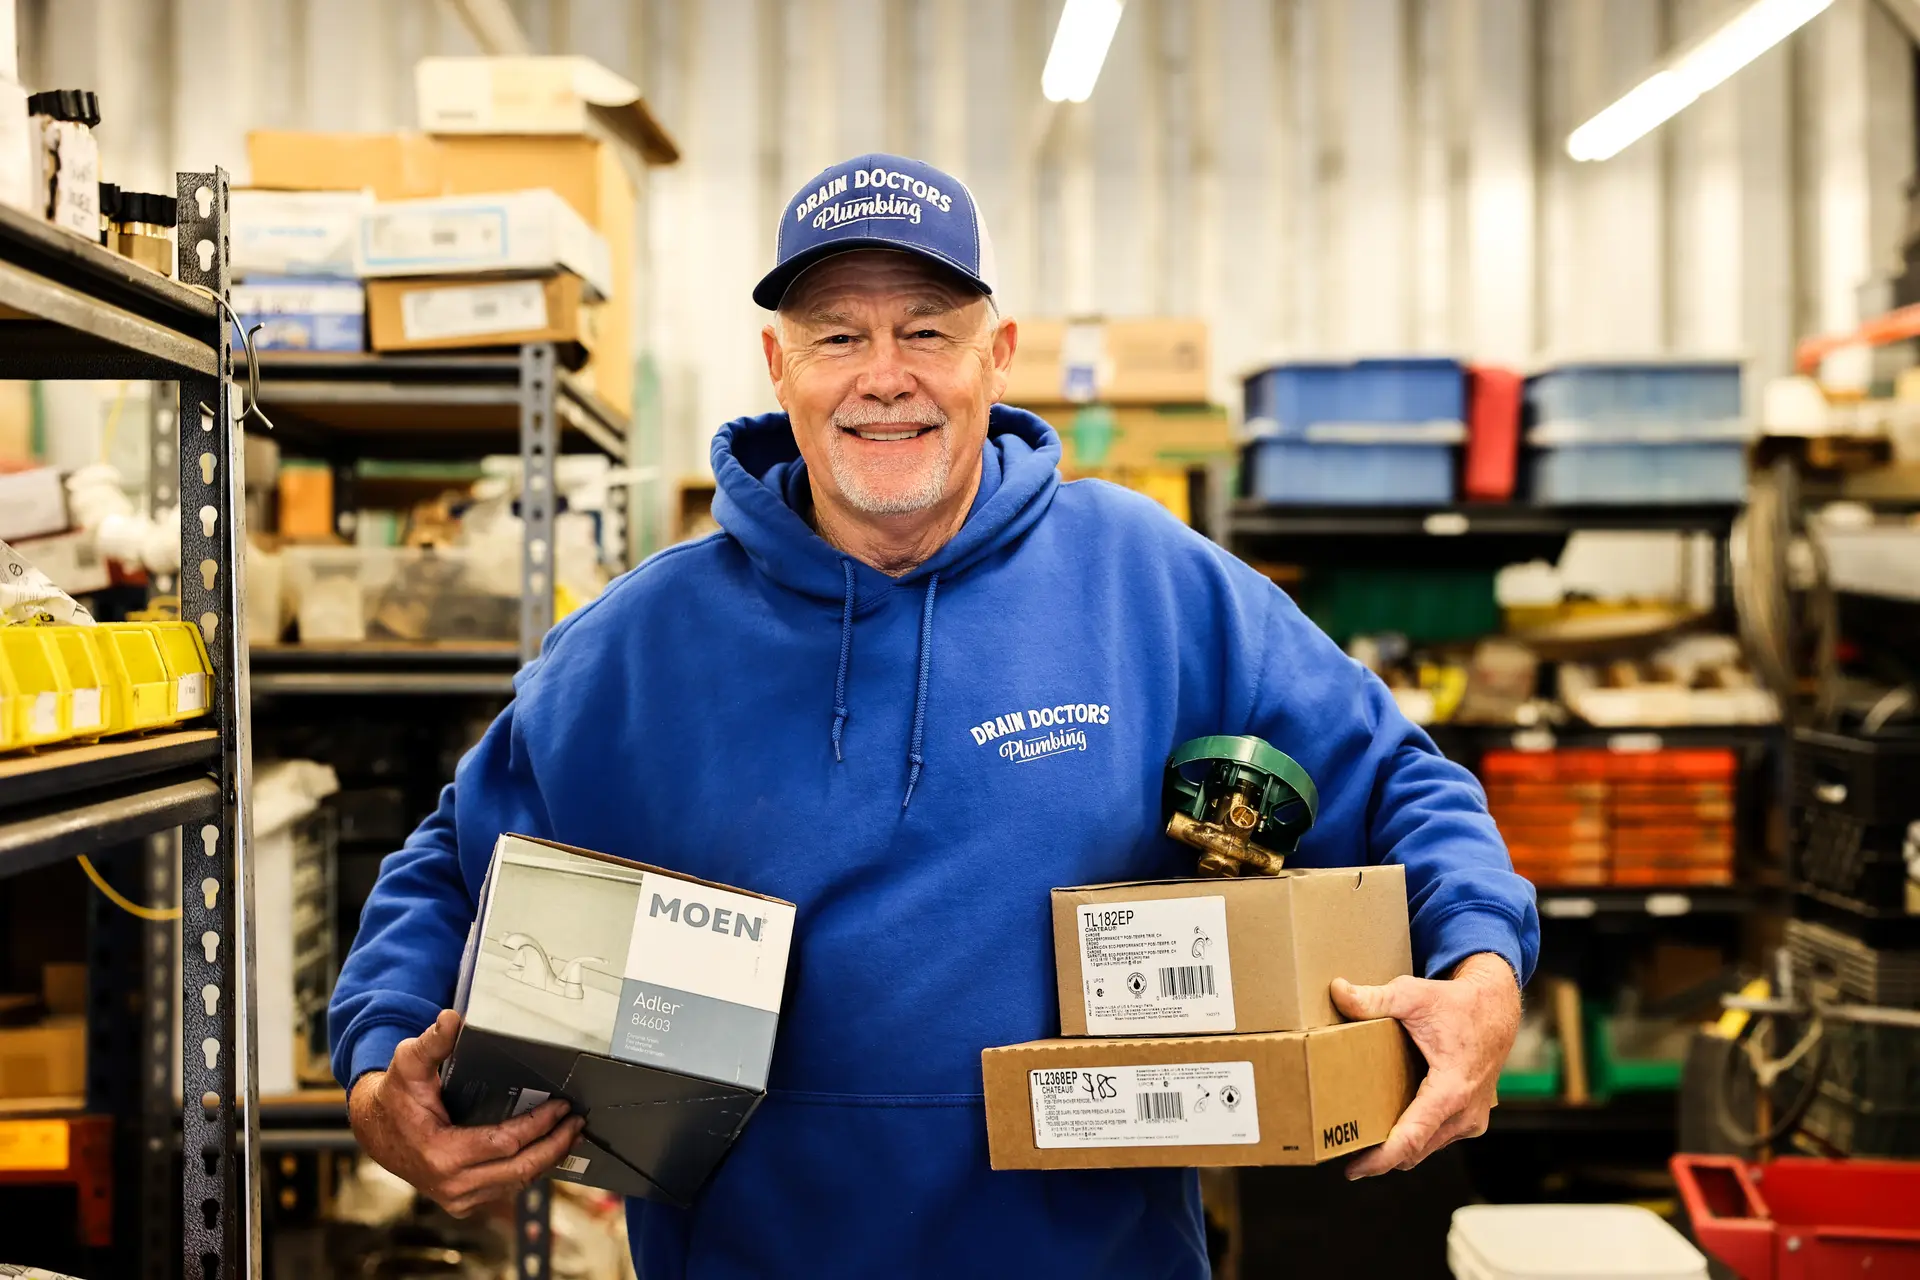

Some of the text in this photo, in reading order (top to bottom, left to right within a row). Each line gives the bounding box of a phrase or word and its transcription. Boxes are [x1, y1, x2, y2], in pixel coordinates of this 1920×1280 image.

[795, 168, 953, 223] DRAIN DOCTORS
[812, 193, 922, 230] Plumbing
[969, 703, 1111, 746] DRAIN DOCTORS
[999, 729, 1087, 761] Plumbing
[1084, 910, 1134, 927] TL182EP
[631, 1012, 671, 1033] 84603
[1033, 1071, 1078, 1086] TL2368EP
[1323, 1120, 1359, 1149] MOEN
